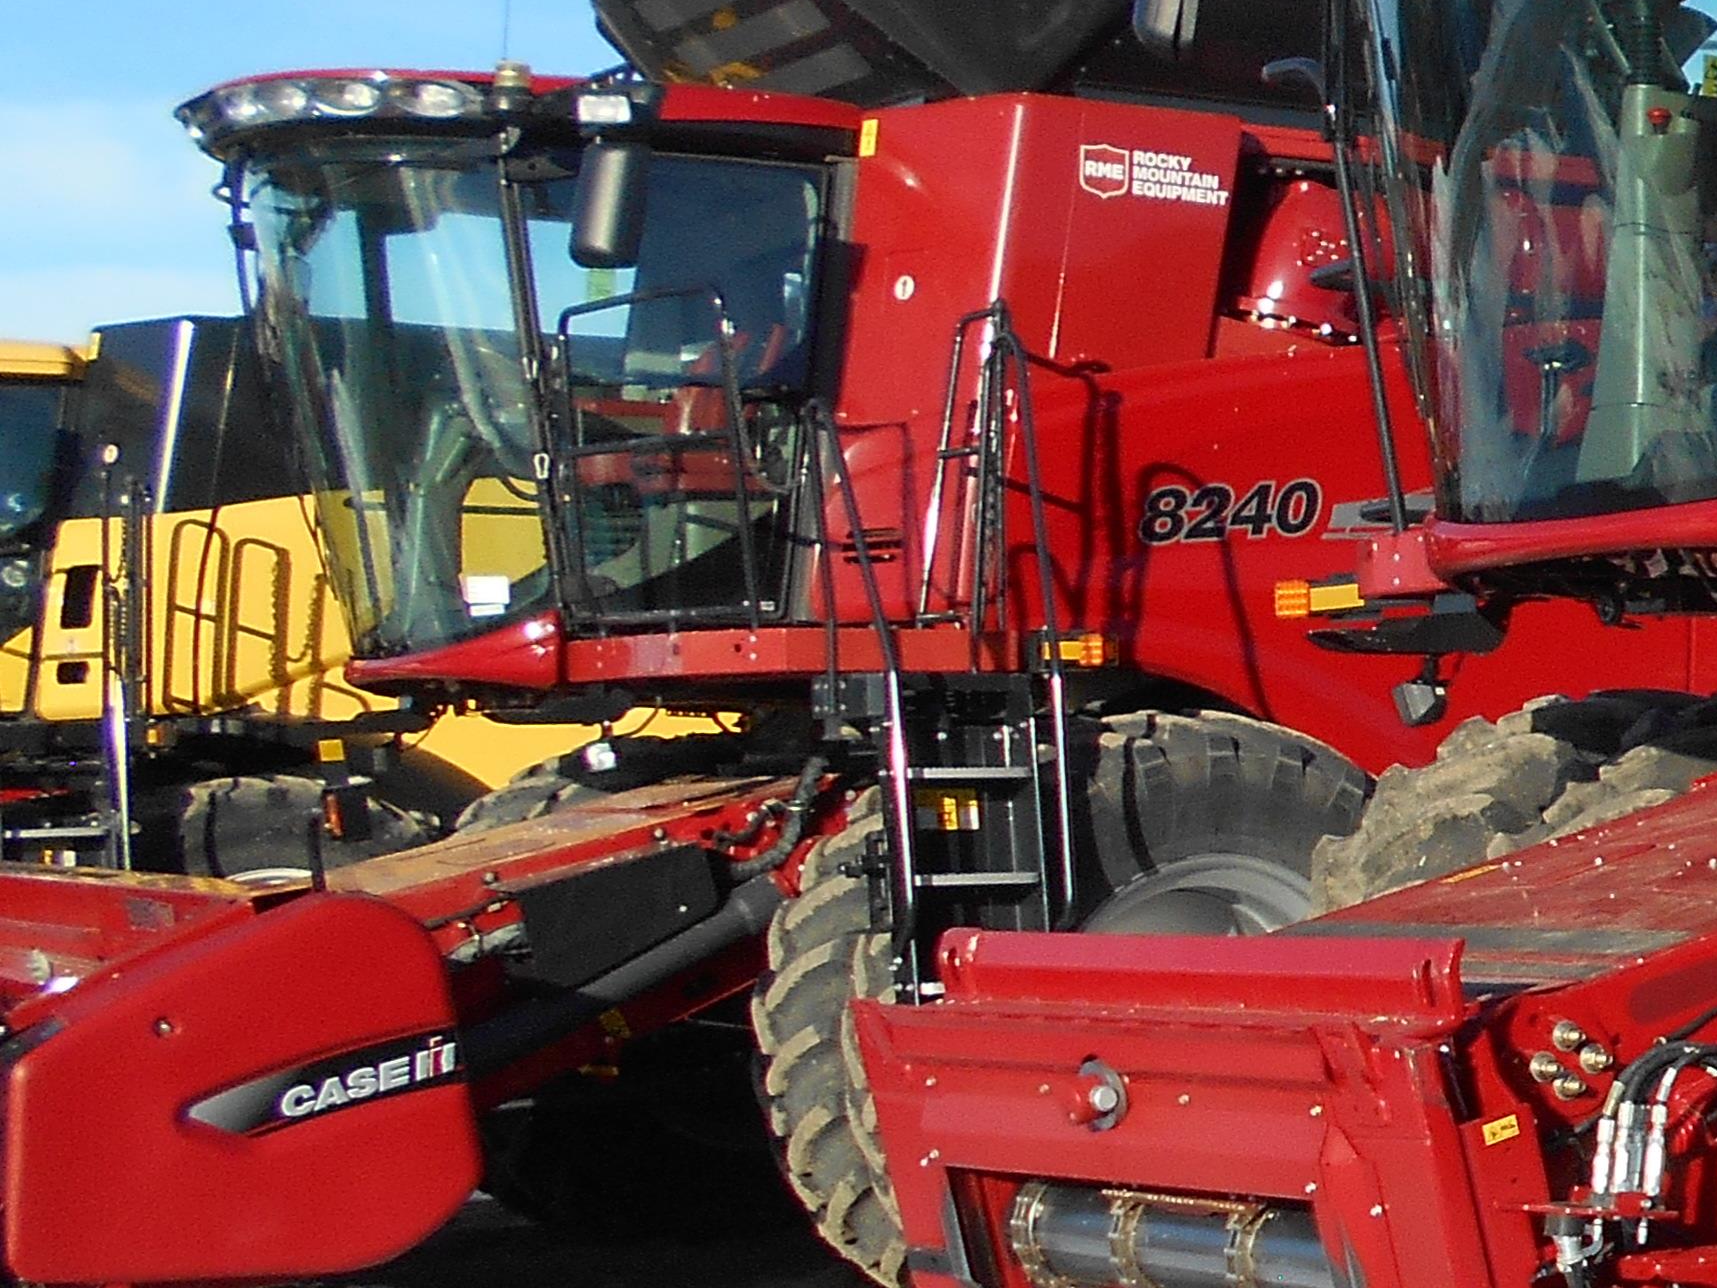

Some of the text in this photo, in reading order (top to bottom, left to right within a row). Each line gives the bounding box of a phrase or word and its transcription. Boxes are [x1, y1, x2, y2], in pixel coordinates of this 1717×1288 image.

[1084, 160, 1125, 180] RME
[1132, 150, 1193, 172] ROCKY
[1132, 165, 1220, 190] MOUNTAIN
[1131, 180, 1230, 206] EQUIPMENT
[1138, 477, 1323, 547] 8240
[281, 1055, 411, 1117] CASE
